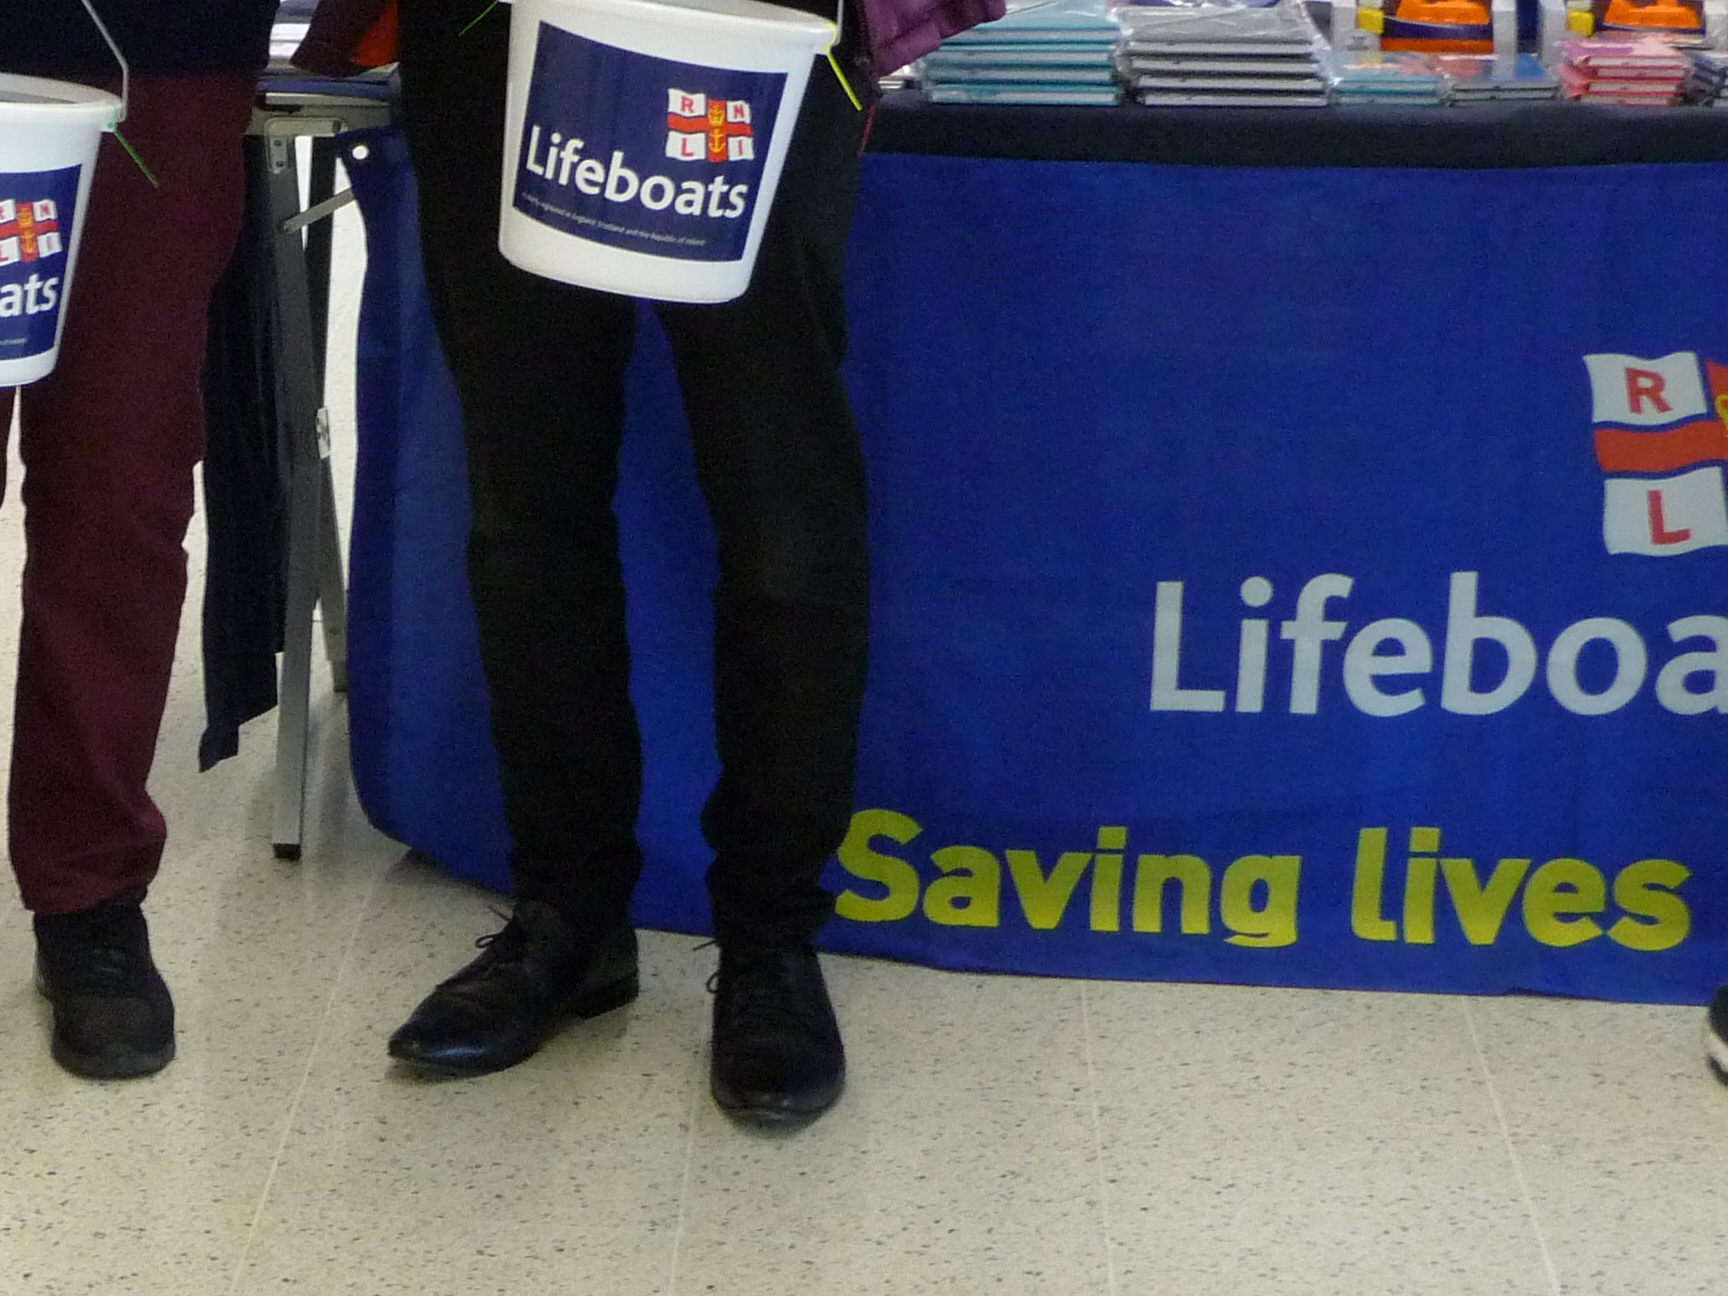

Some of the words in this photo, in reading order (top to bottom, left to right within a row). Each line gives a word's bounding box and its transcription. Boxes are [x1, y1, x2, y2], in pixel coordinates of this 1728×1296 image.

[680, 94, 695, 114] R
[526, 124, 750, 219] Lifeboats
[680, 137, 695, 157] L
[1622, 367, 1673, 416] R
[1646, 490, 1692, 546] L
[1149, 570, 1728, 717] Lifeboa
[834, 808, 1302, 948] Saving
[1352, 825, 1692, 952] lives
